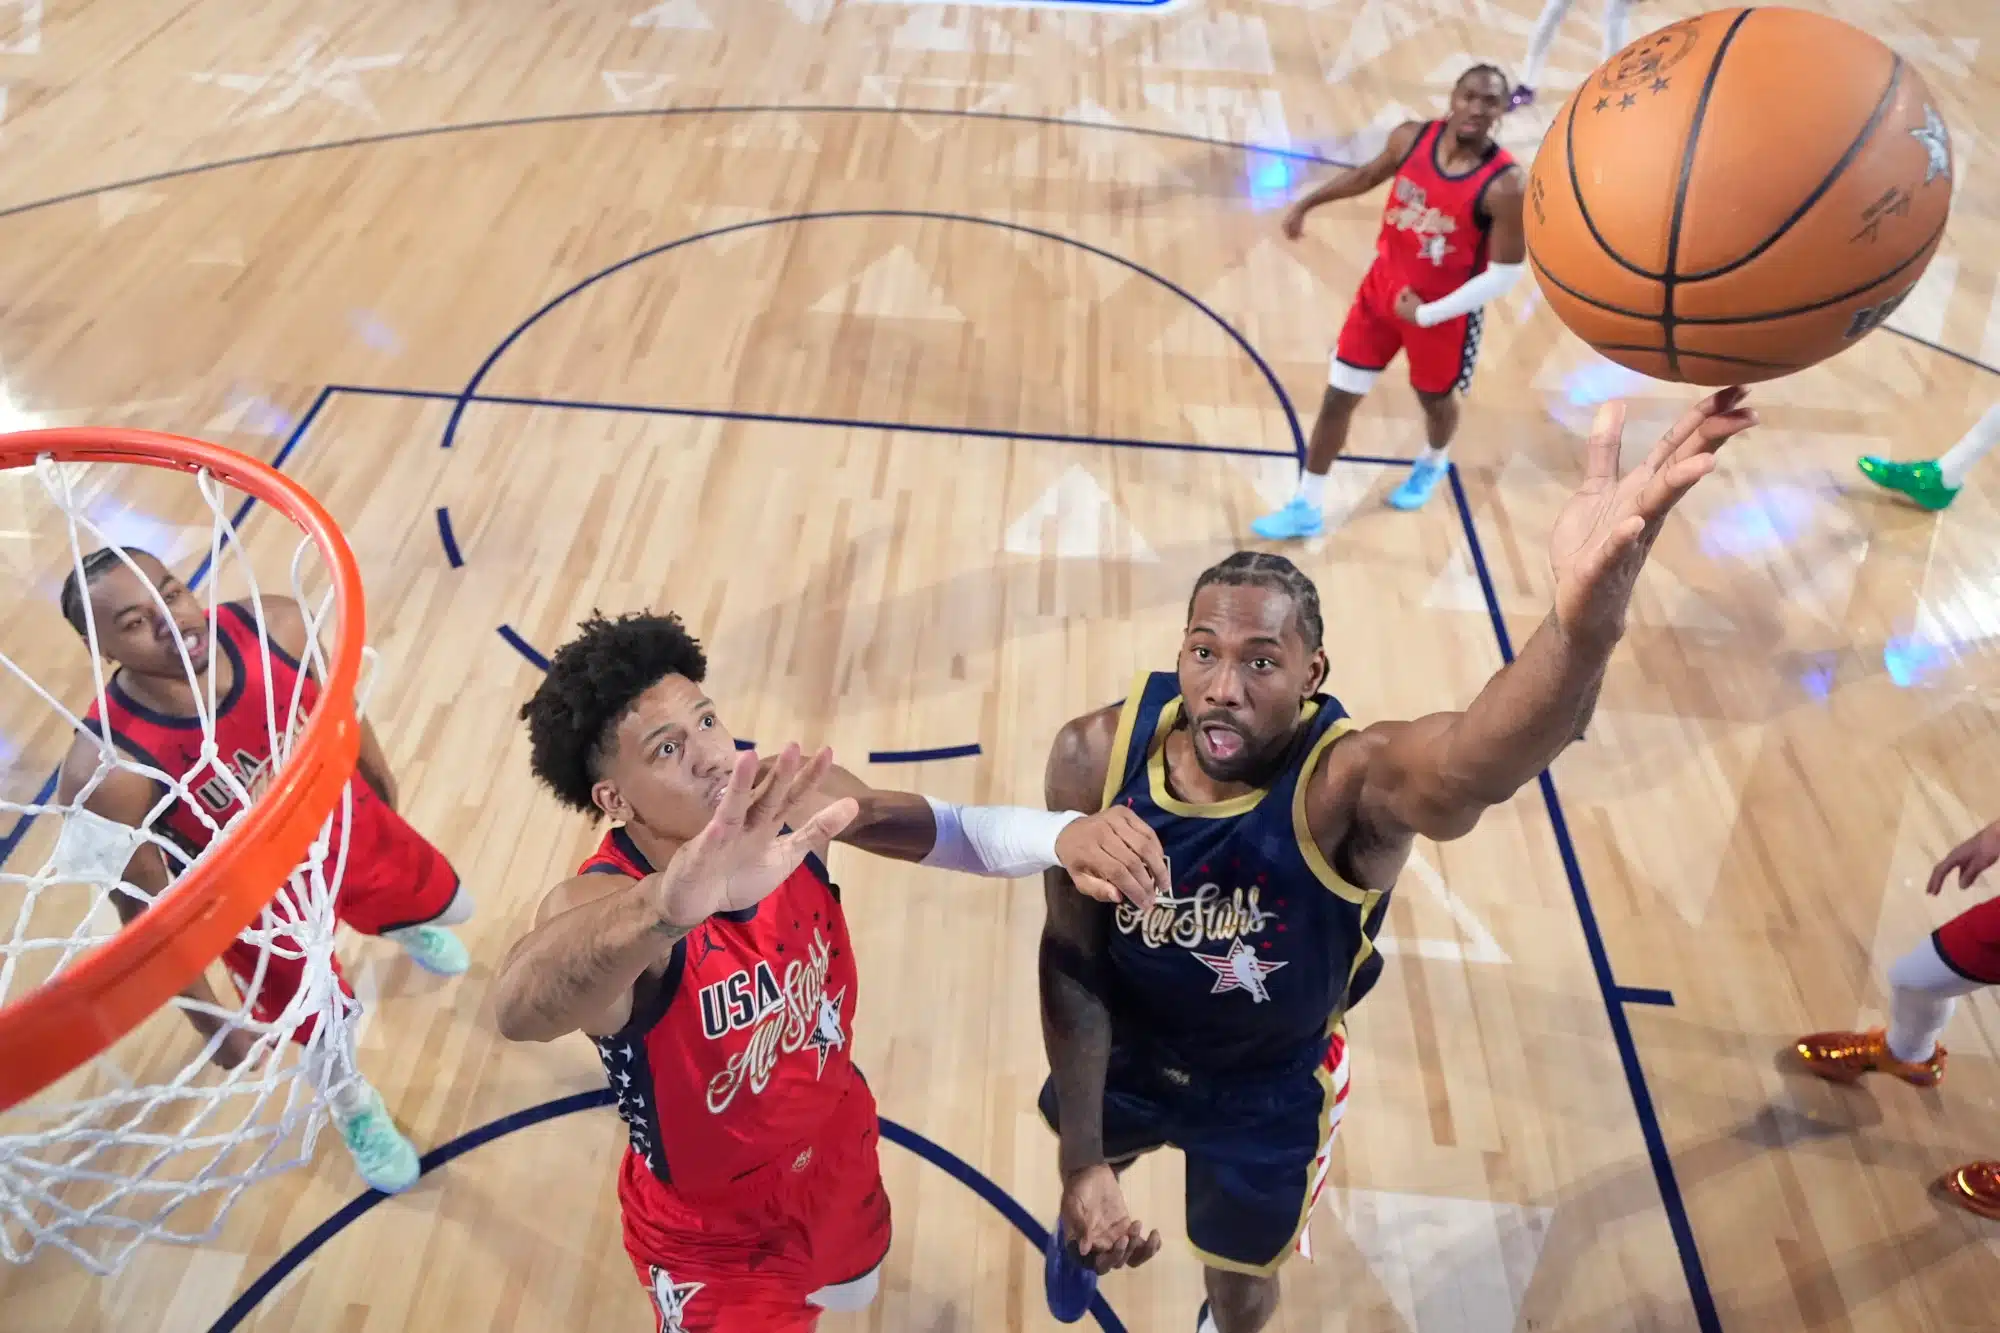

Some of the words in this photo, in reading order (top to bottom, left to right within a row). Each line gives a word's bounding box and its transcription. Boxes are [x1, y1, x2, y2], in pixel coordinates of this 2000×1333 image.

[1170, 882, 1279, 948] Stars
[699, 960, 785, 1040] USA
[706, 1014, 784, 1114] All
[781, 927, 831, 1054] Stars
